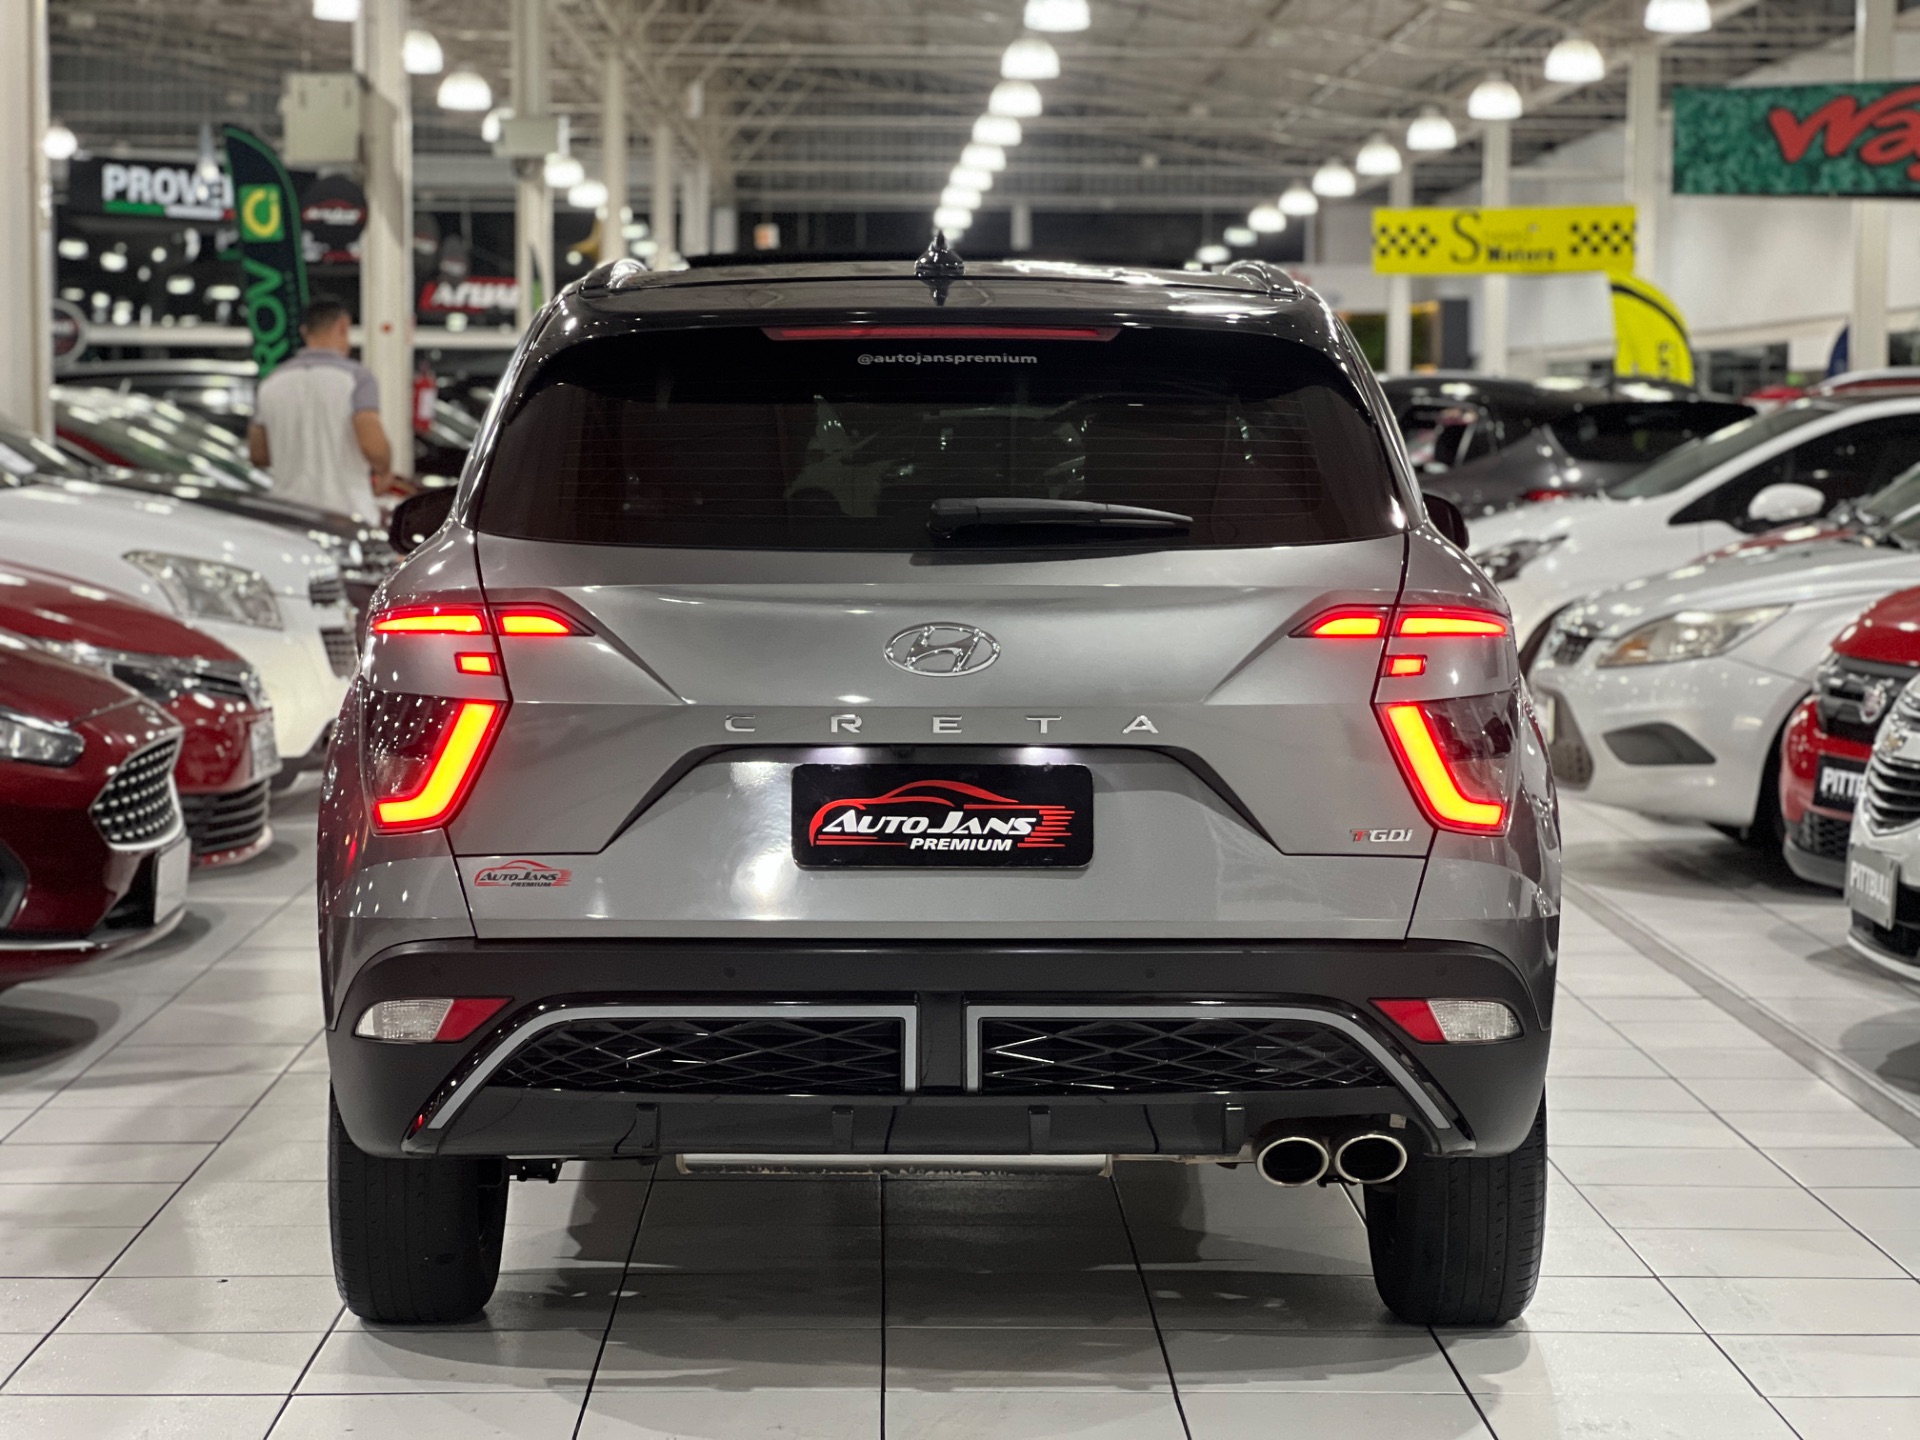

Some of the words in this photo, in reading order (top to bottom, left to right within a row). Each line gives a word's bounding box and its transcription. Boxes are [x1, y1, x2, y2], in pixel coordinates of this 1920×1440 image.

[857, 353, 1038, 365] @autojanspremium
[724, 714, 1159, 734] CRETA
[909, 837, 1013, 851] PREMIUM
